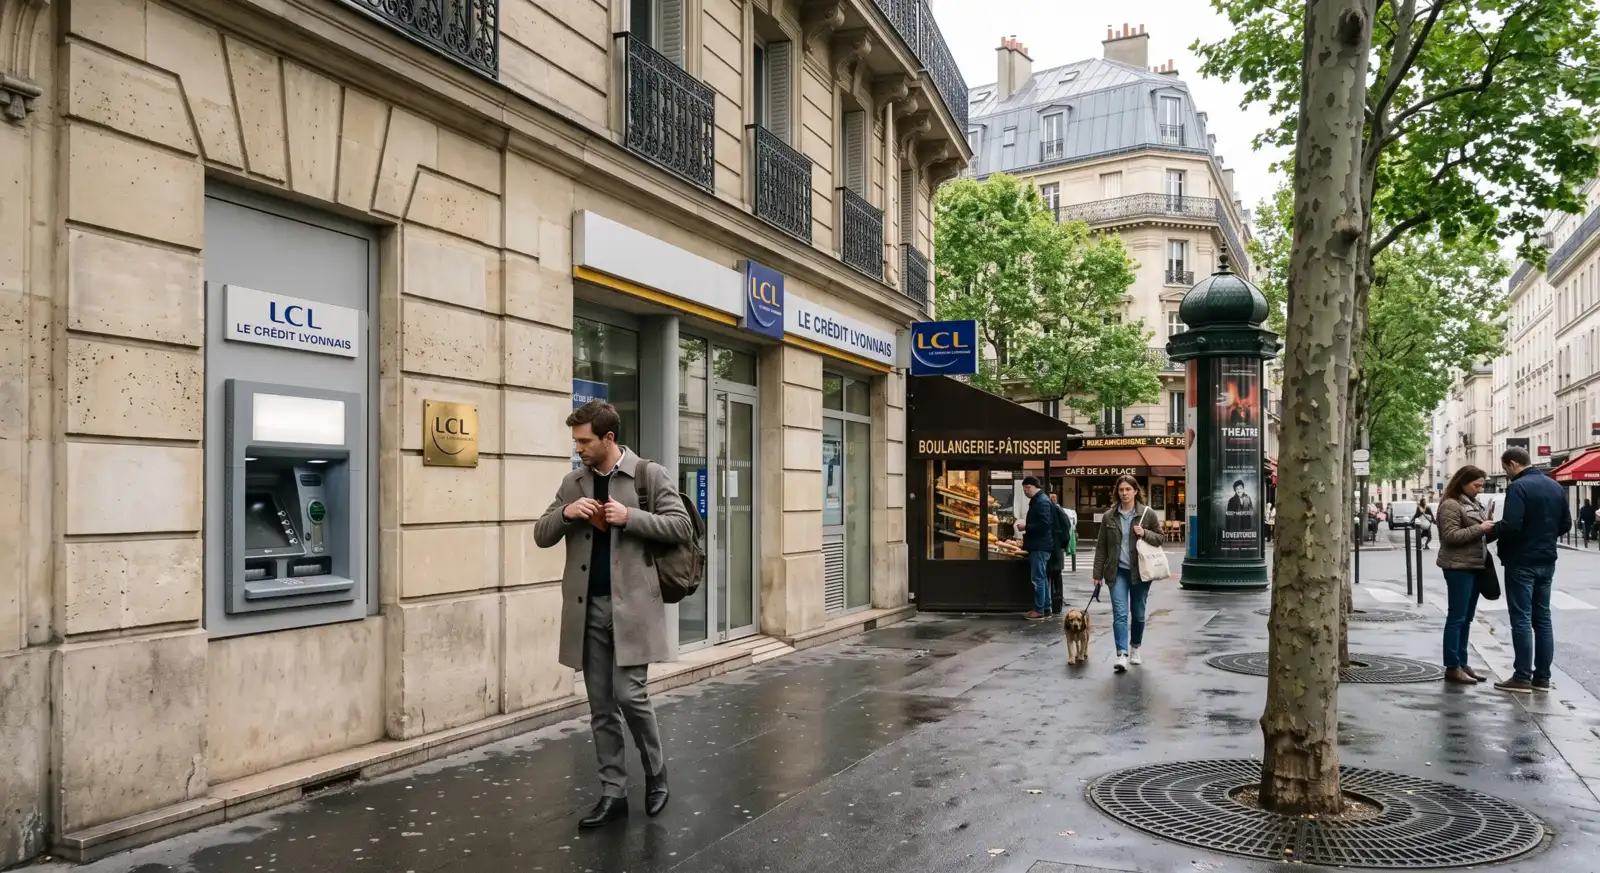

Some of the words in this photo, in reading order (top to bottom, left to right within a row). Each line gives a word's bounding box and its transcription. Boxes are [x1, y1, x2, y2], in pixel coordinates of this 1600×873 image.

[752, 277, 781, 307] LCL
[269, 302, 322, 330] LCL
[236, 323, 251, 334] LE
[254, 325, 296, 341] CRÉDIT
[299, 333, 351, 349] LYONNAIS
[798, 310, 811, 330] LE
[814, 316, 848, 342] CRÉDIT
[850, 330, 892, 357] LYONNAIS
[917, 331, 969, 349] LCL
[435, 416, 469, 435] LCL
[918, 437, 1061, 455] BOULANGERIE-PÂTISSERIE
[1155, 437, 1174, 445] CAFÉ
[1065, 467, 1085, 475] CAFÉ
